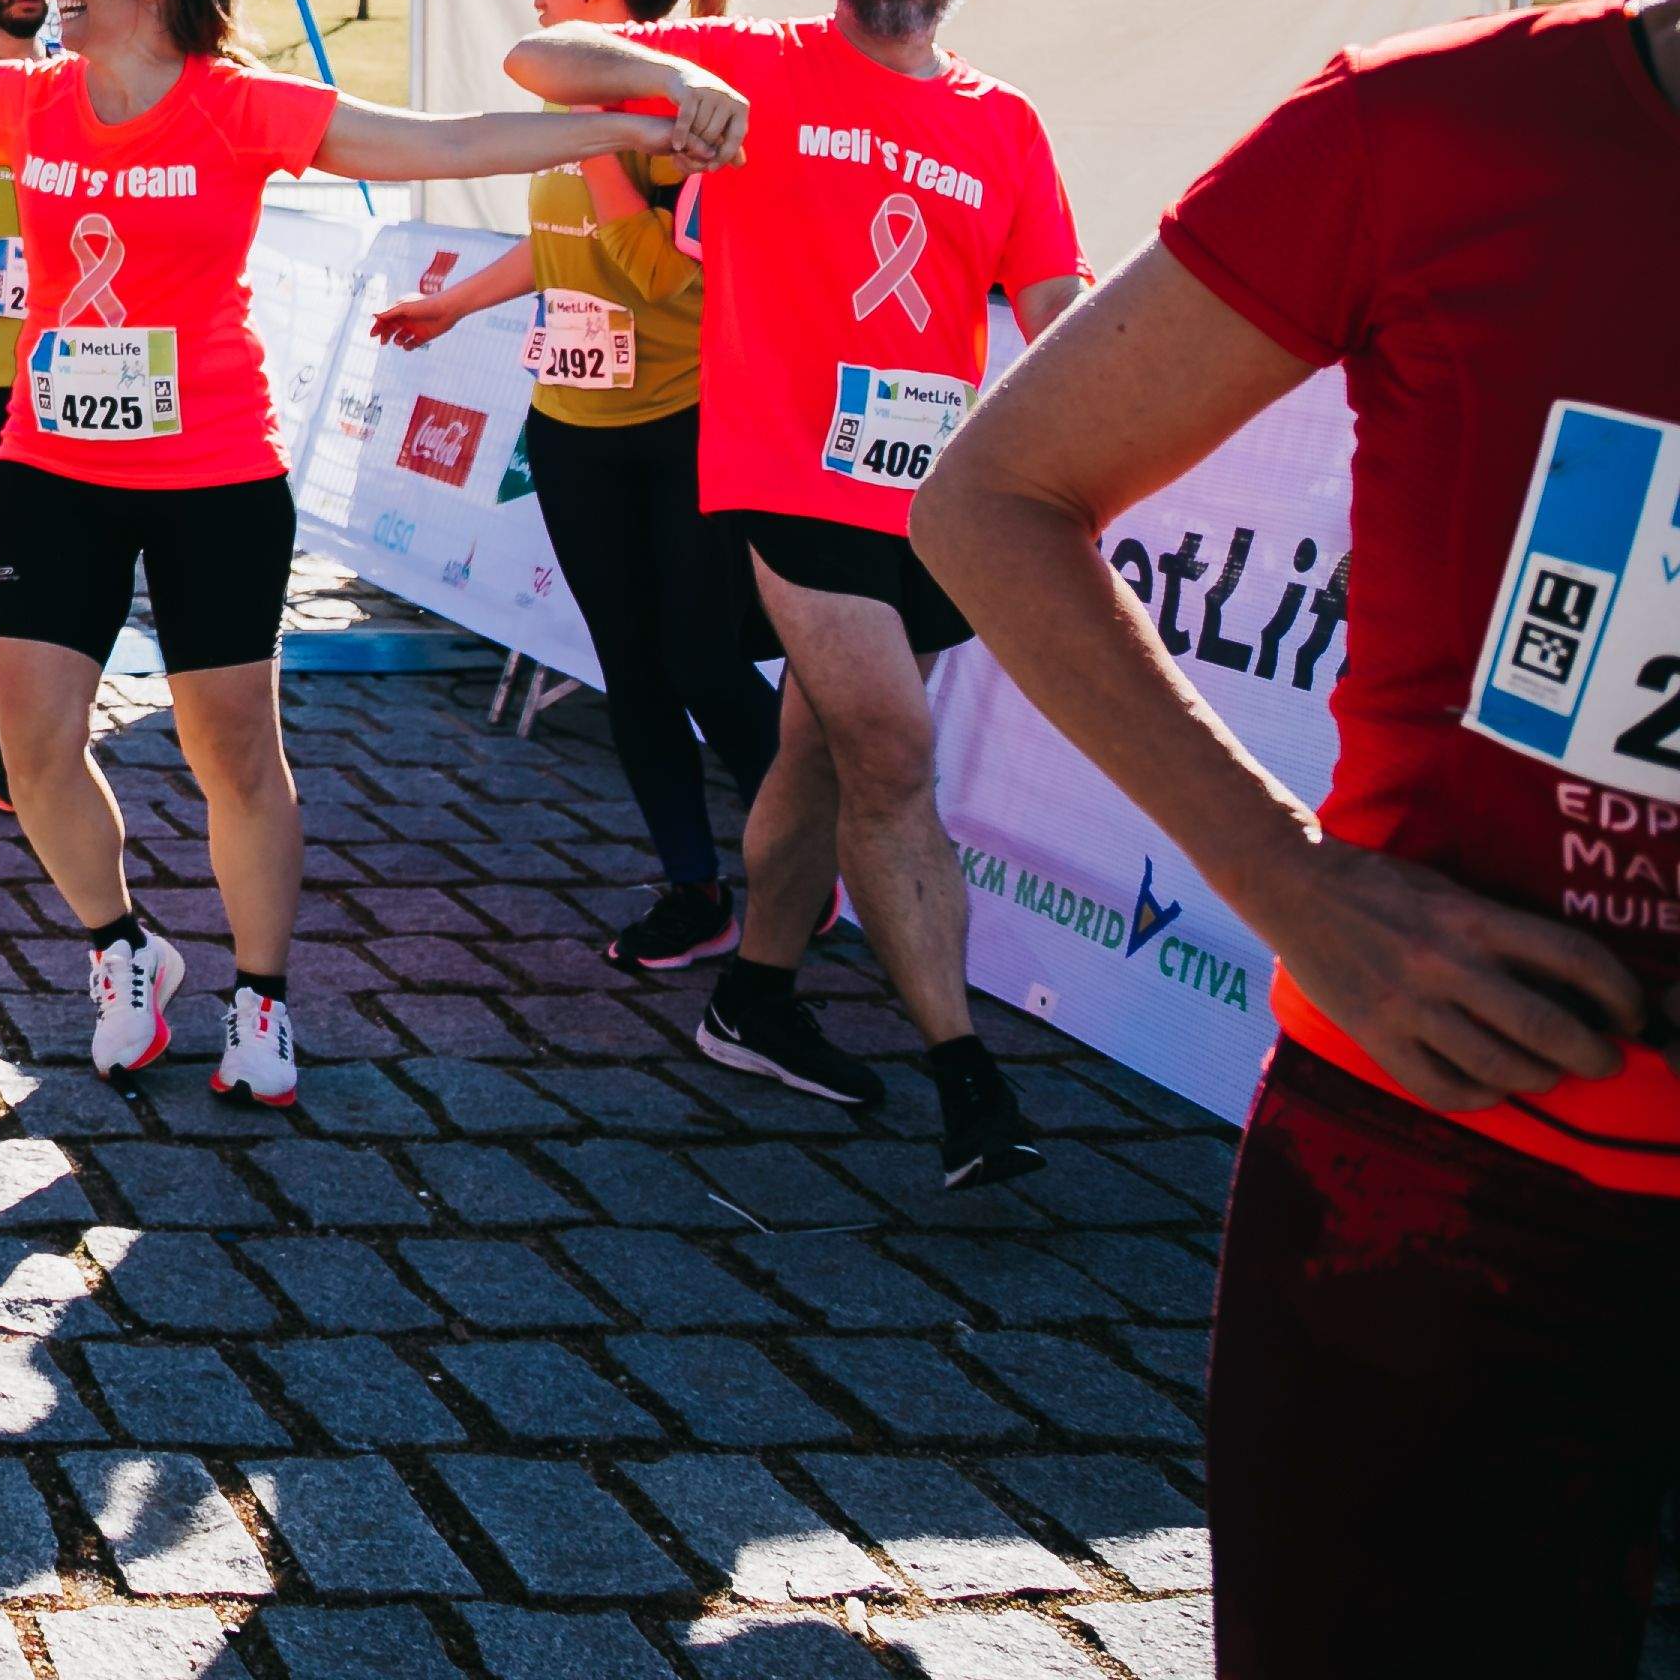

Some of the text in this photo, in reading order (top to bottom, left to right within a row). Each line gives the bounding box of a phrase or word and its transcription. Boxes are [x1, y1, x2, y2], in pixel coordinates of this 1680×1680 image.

[902, 149, 984, 210] Team
[556, 302, 603, 314] MetLife
[81, 341, 141, 357] MetLife
[61, 394, 143, 431] 4225
[904, 386, 962, 407] MetLife
[862, 439, 934, 480] 406
[1097, 526, 1351, 692] etLif
[1562, 831, 1680, 900] MA
[950, 839, 1008, 897] KM
[1013, 869, 1126, 950] MADRID
